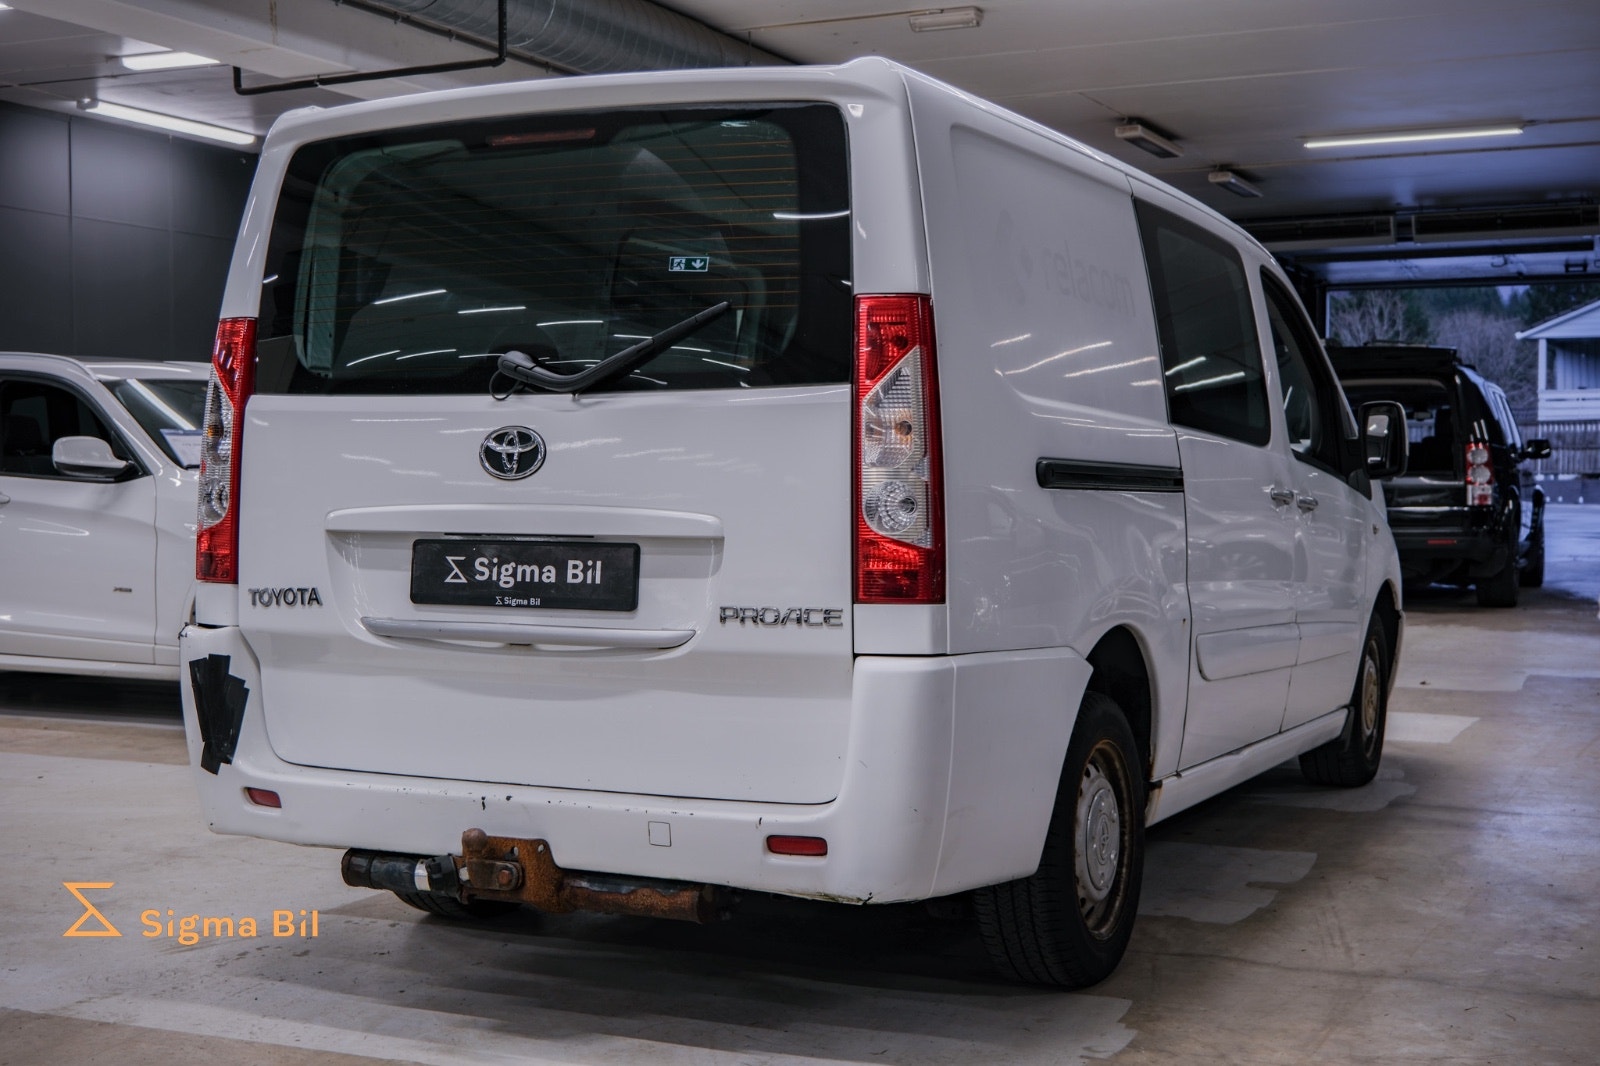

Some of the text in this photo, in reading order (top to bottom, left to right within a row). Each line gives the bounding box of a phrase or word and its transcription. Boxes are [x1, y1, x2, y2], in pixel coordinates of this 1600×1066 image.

[474, 557, 602, 588] Sigma Bil
[248, 587, 323, 607] TOYOTA
[504, 596, 541, 607] Sigma Bil
[719, 606, 843, 627] PROACE
